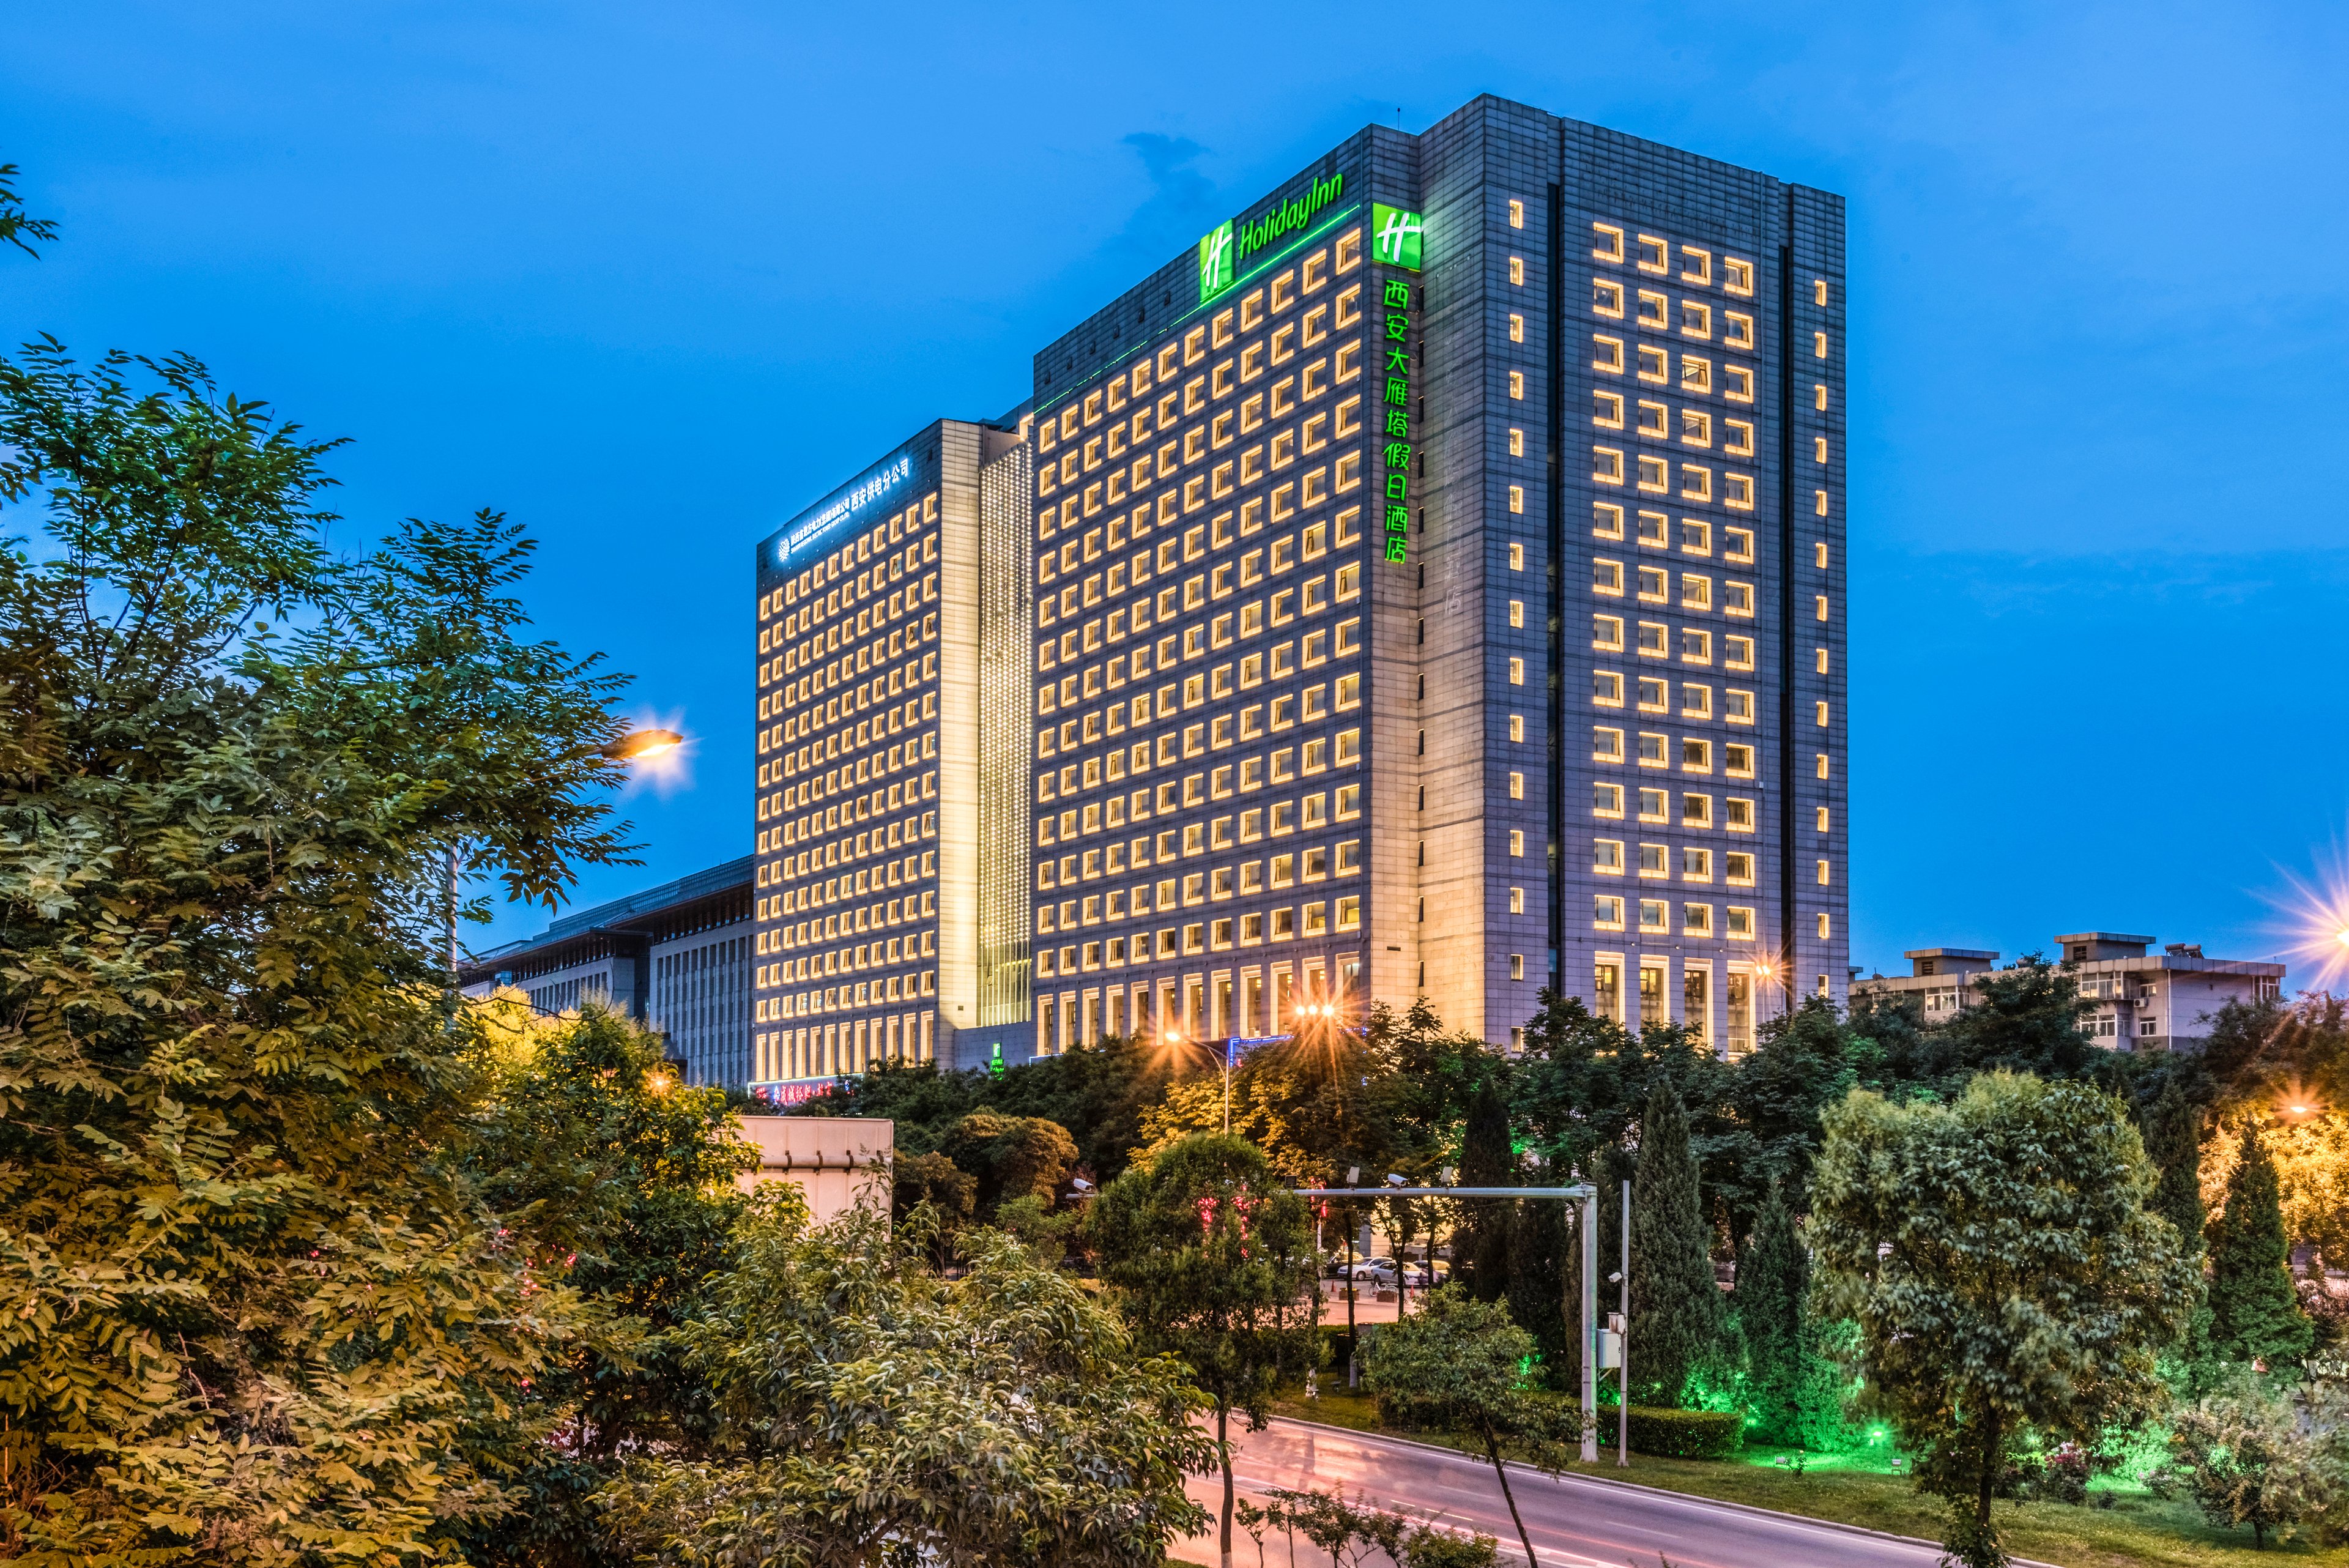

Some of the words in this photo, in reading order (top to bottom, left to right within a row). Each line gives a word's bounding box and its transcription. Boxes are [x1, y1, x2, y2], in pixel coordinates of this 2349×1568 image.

[852, 458, 908, 511] 西安供电分公司
[1383, 280, 1411, 563] 西安大雁塔假日酒店
